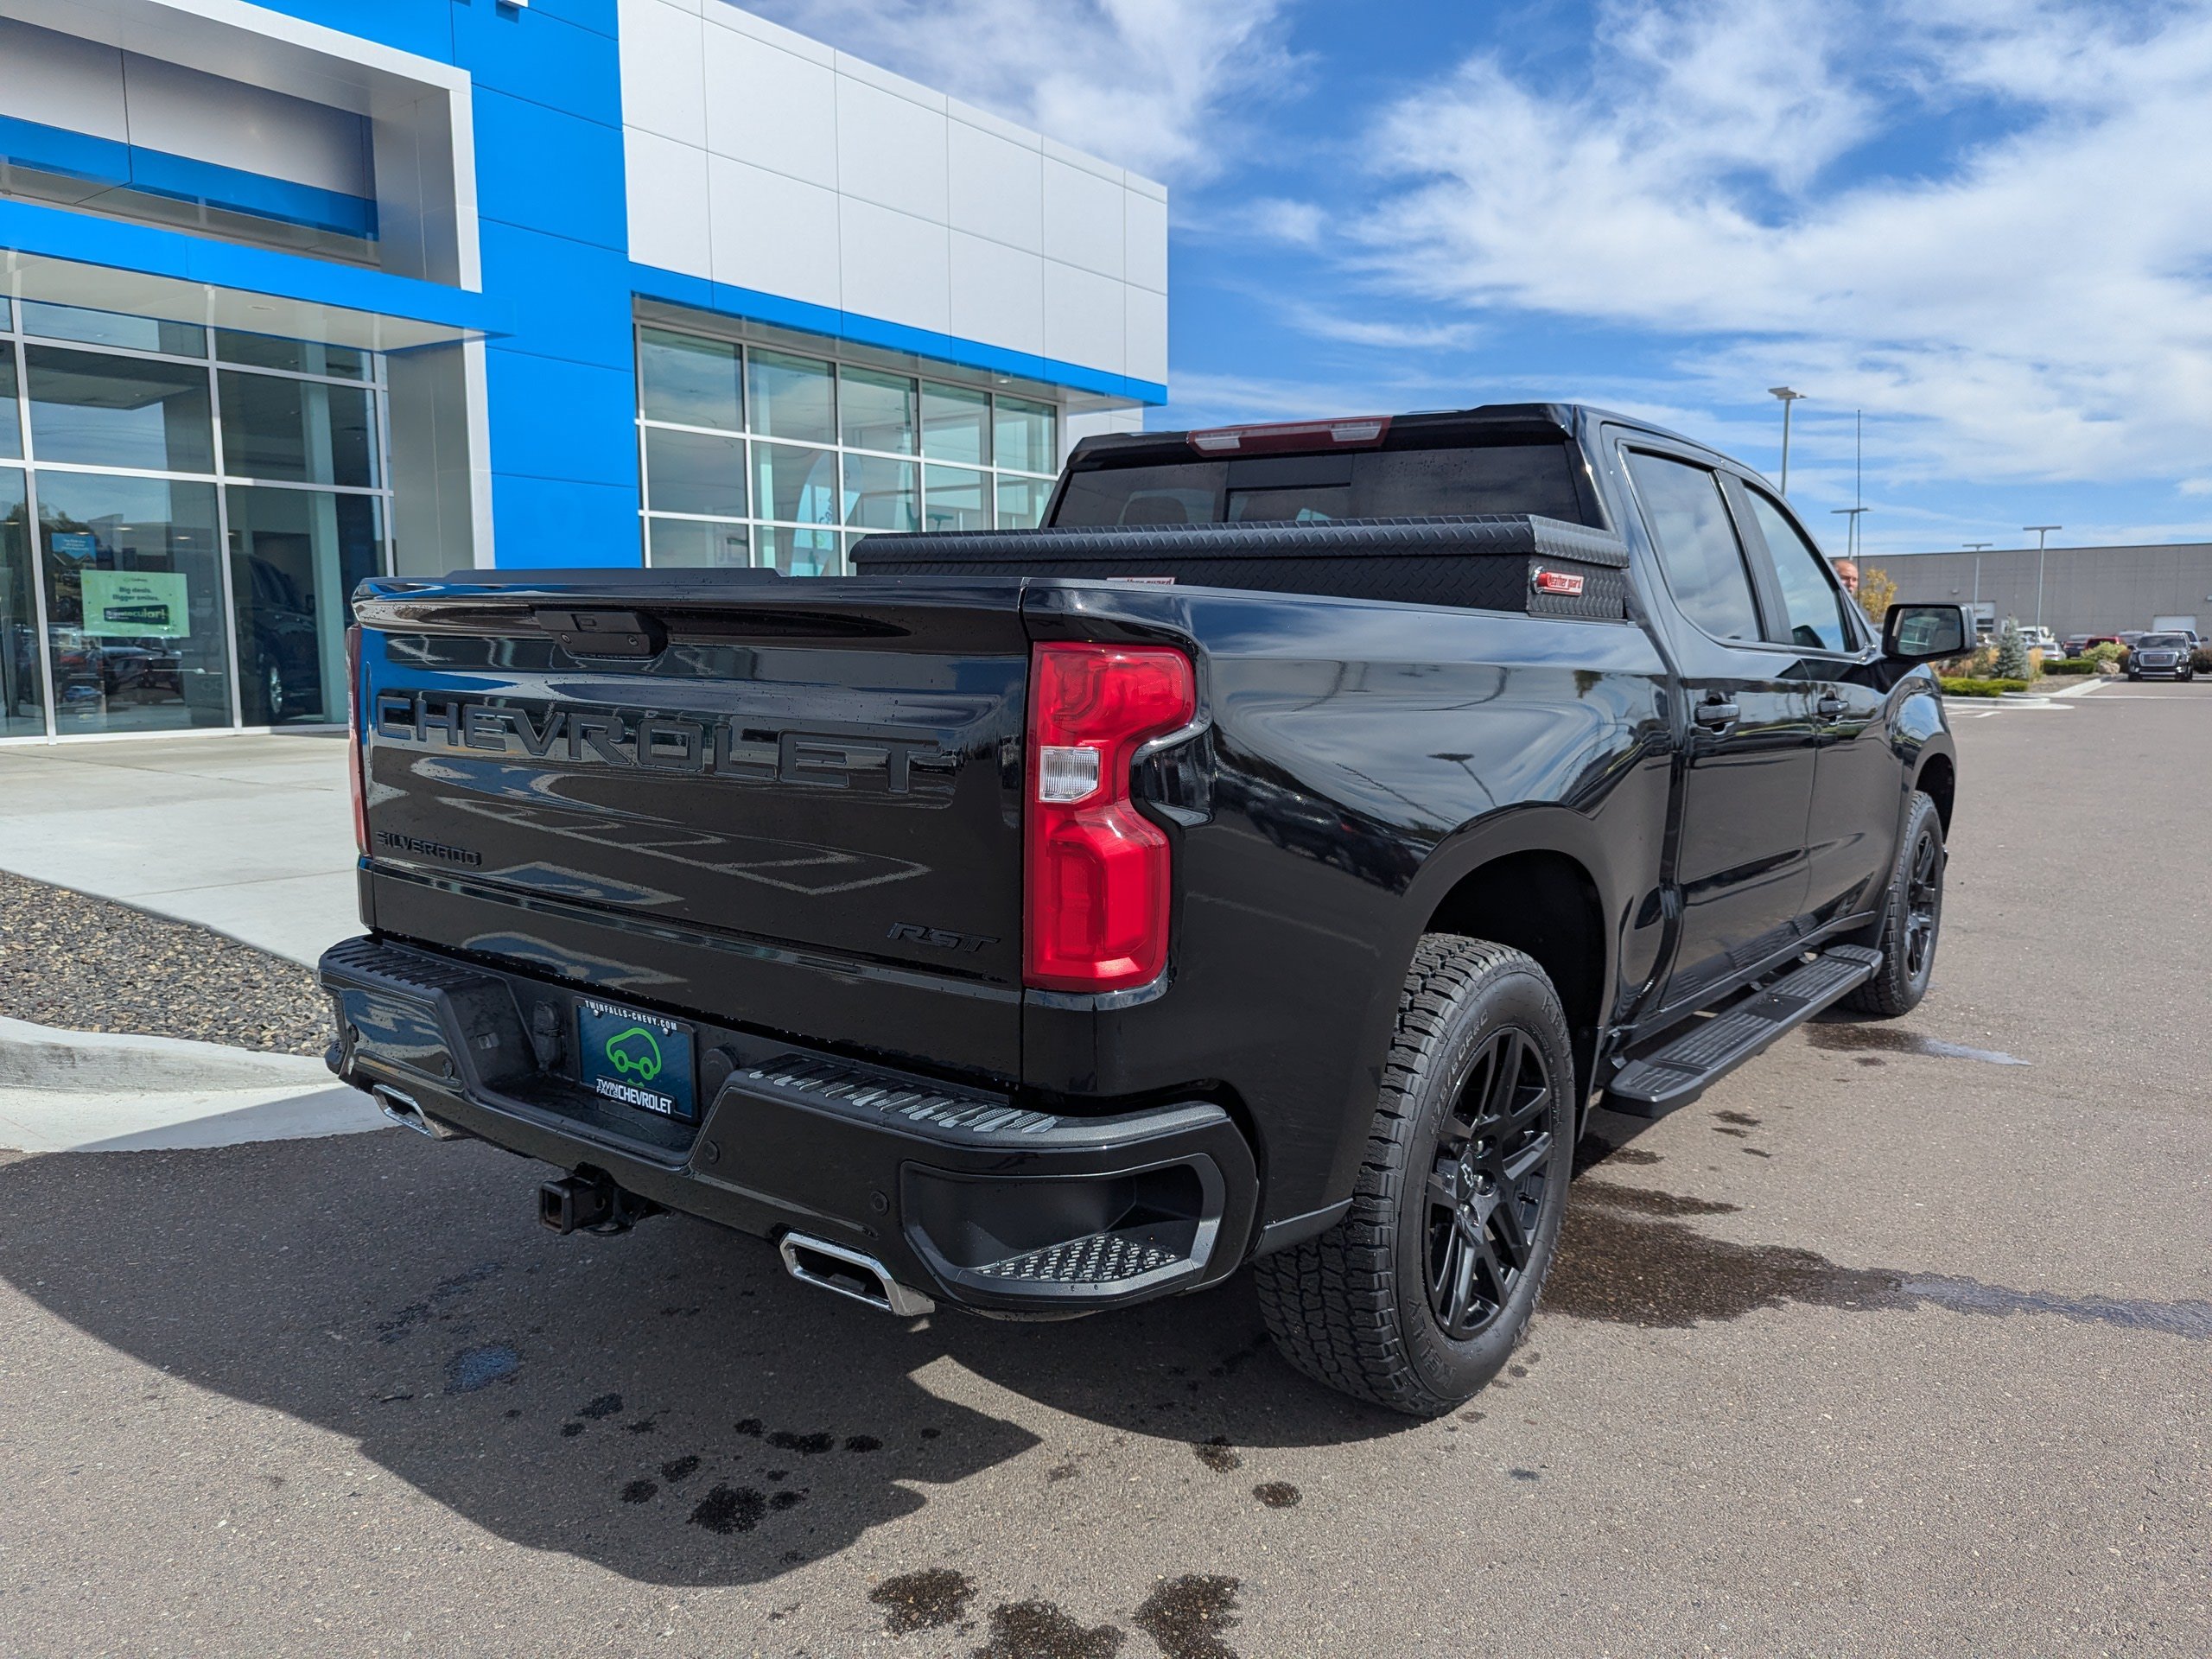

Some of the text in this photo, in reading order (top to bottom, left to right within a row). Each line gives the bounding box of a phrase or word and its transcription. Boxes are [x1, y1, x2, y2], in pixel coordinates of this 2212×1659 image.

[112, 594, 135, 602] Bigger
[375, 694, 944, 794] CHEVROLET
[374, 830, 482, 867] SILVERADO
[887, 921, 1001, 952] RST
[584, 1000, 677, 1031] TWINFALLS-CHEVY.COM
[596, 1078, 619, 1091] TWIN
[596, 1085, 619, 1098] FALLS
[618, 1084, 672, 1115] CHEVROLET
